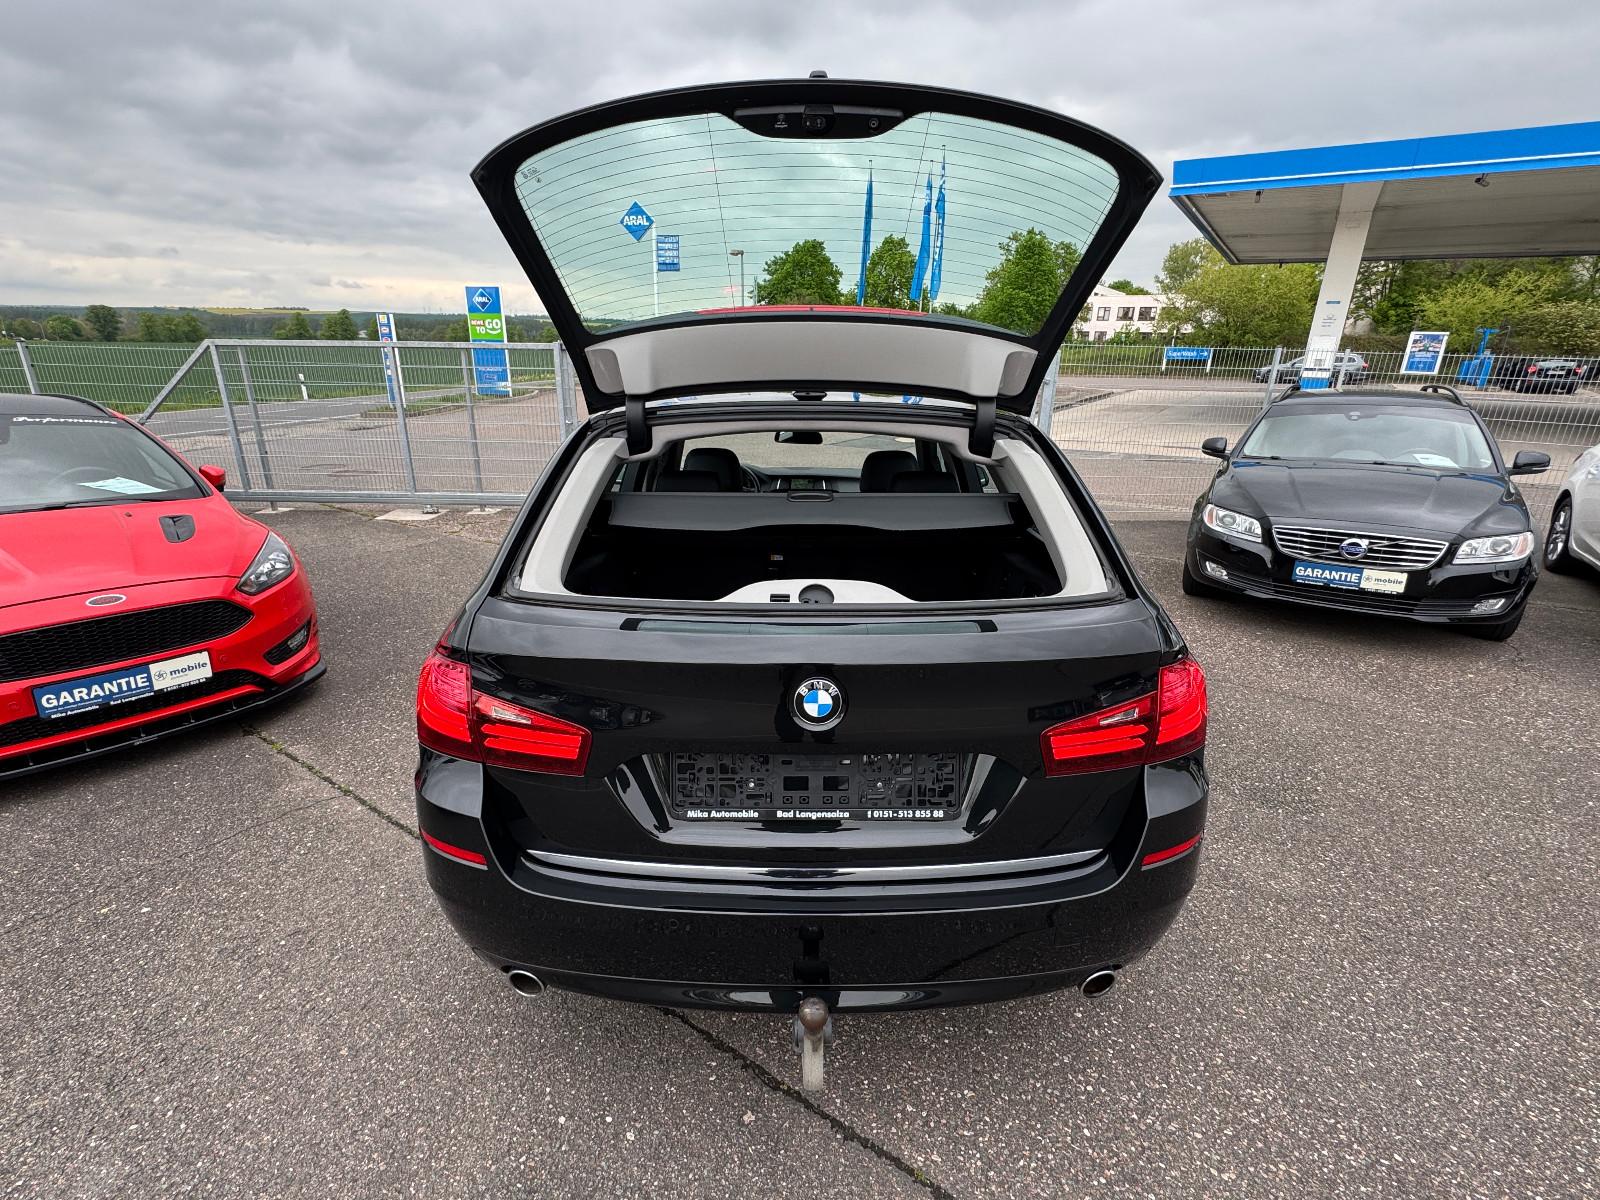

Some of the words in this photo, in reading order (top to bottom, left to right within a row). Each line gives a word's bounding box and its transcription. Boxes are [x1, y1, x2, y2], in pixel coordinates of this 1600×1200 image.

[623, 215, 650, 226] ARAL
[485, 318, 502, 329] GO
[476, 326, 486, 334] TO
[12, 416, 118, 425] Performance
[1295, 566, 1361, 583] GARANTIE
[1374, 577, 1404, 586] mobile
[169, 661, 208, 677] mobile
[41, 673, 150, 708] GARANTIE
[798, 681, 839, 697] BMW
[686, 810, 708, 818] Mika
[710, 810, 759, 818] Automobile
[776, 810, 793, 818] Bad
[795, 810, 850, 819] Langensalza
[873, 810, 913, 818] 0151-513
[915, 810, 931, 818] 855
[932, 810, 944, 818] 88
